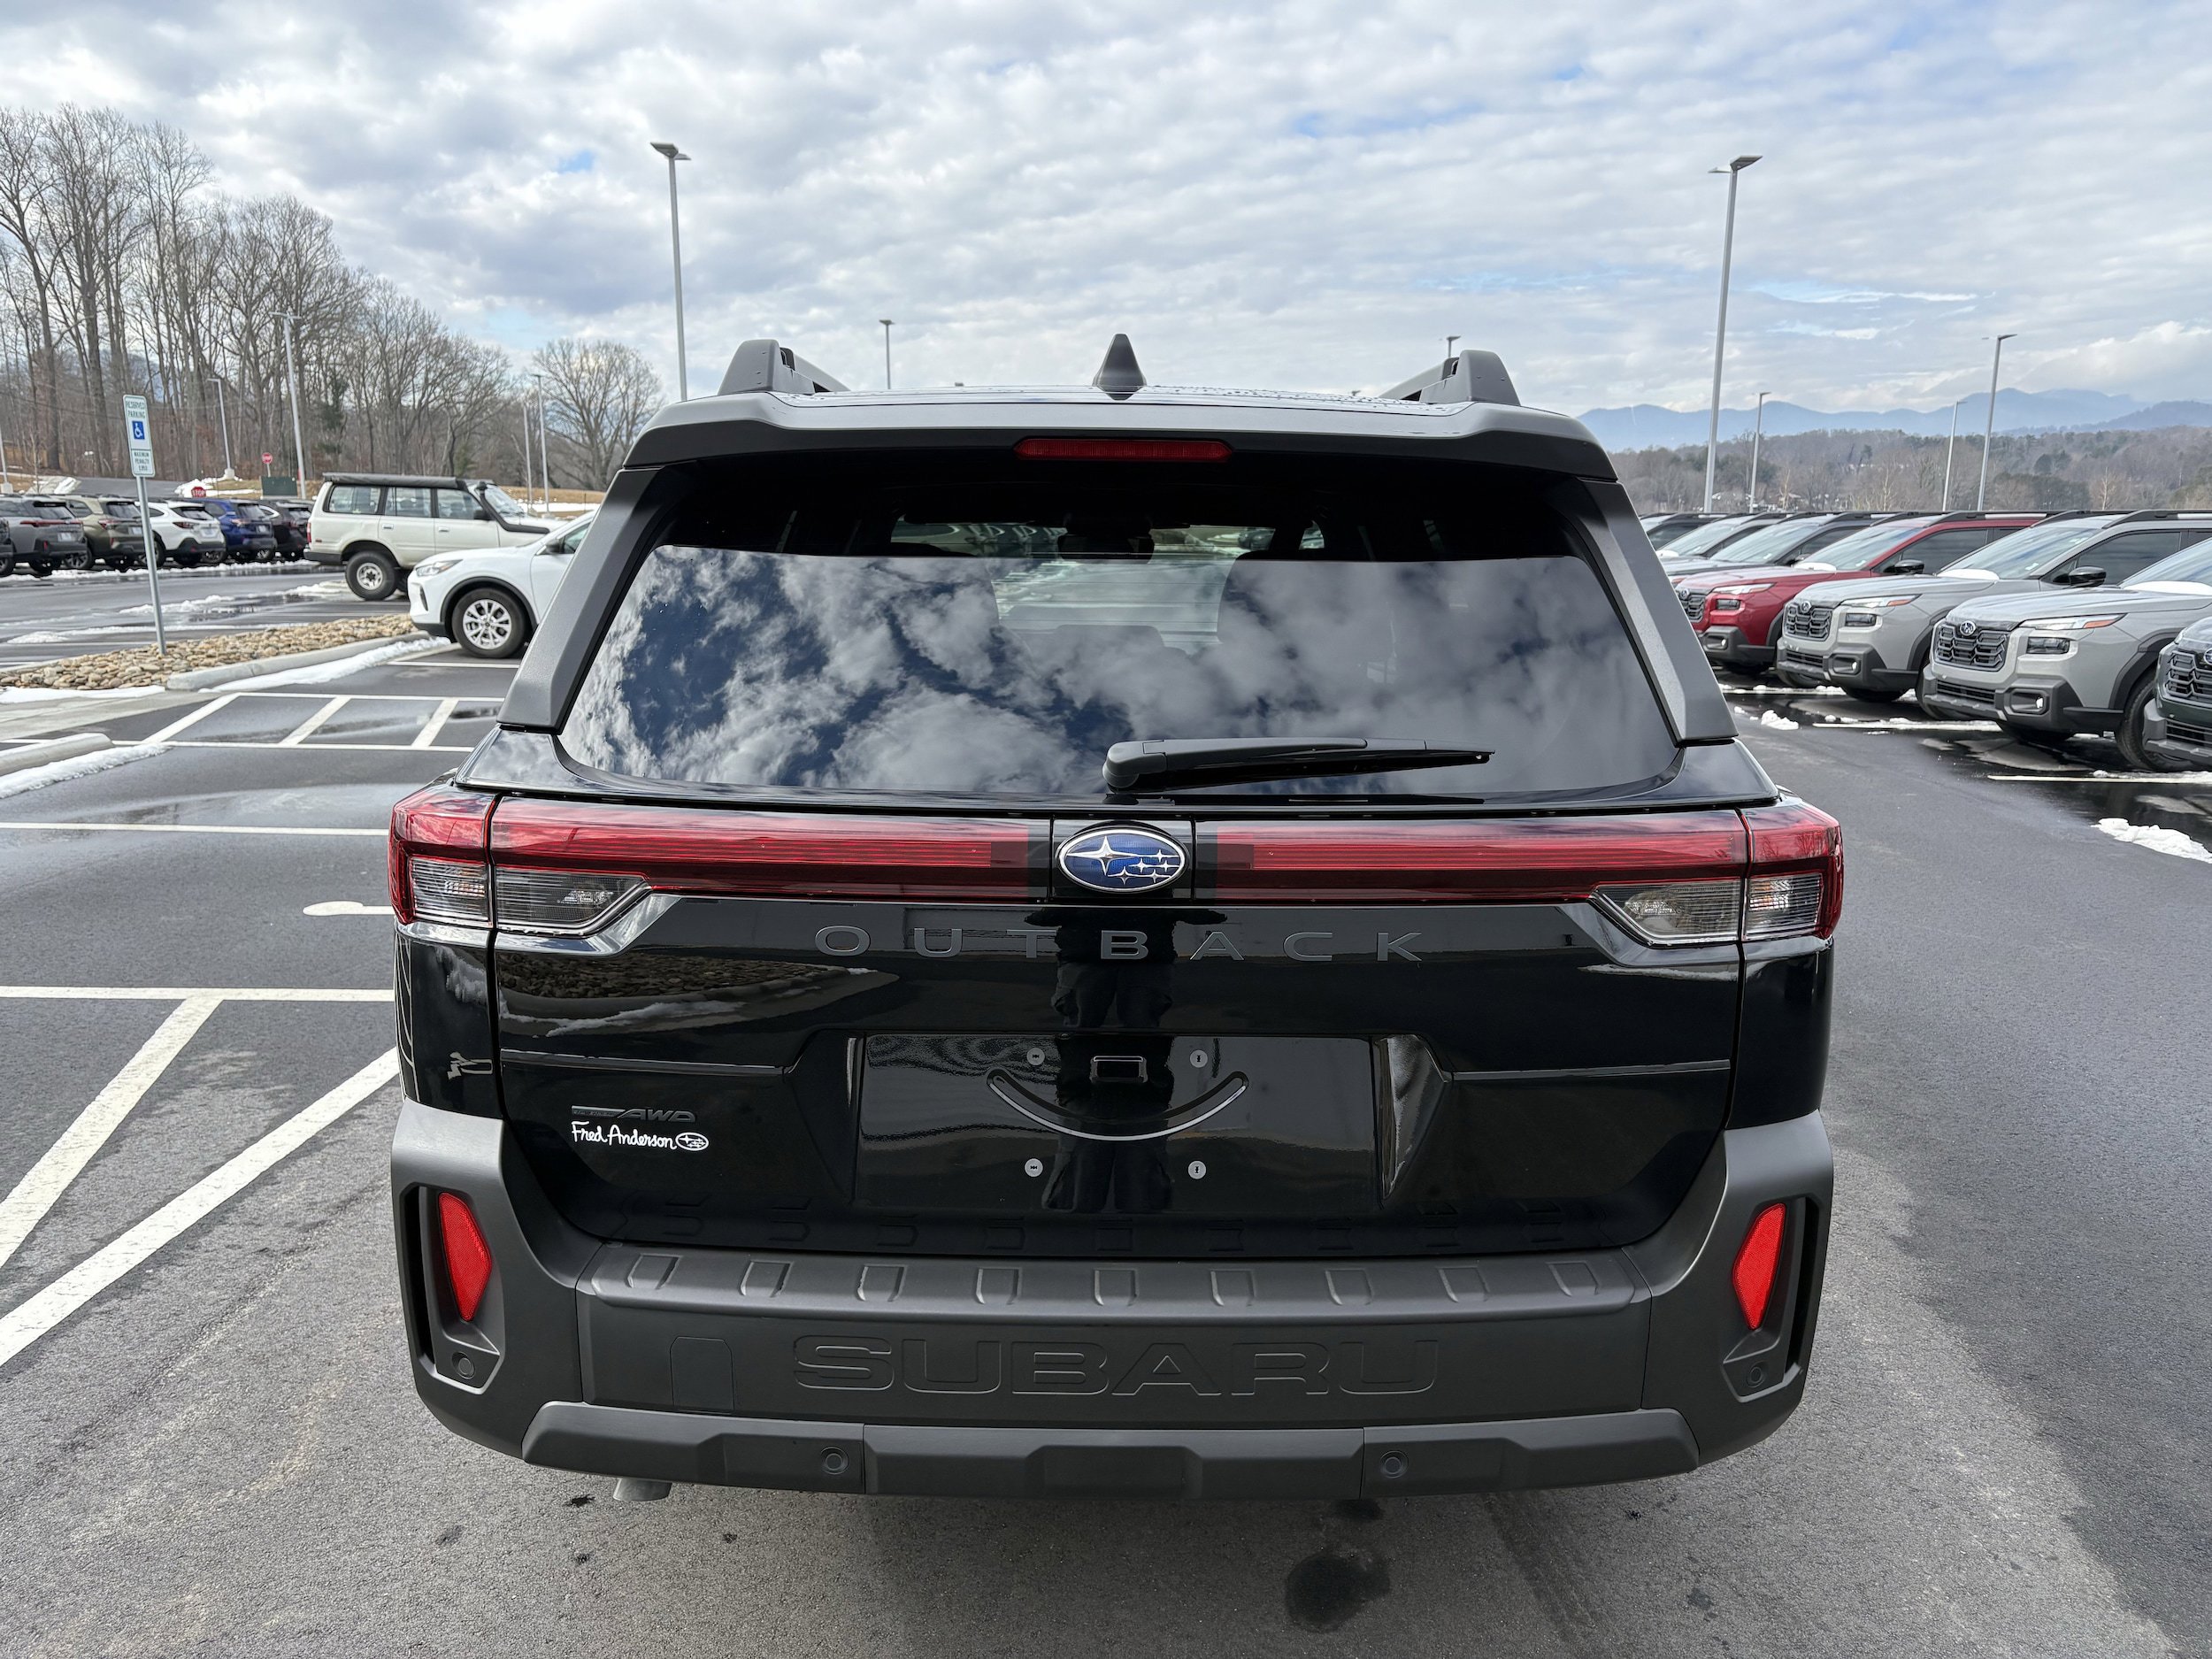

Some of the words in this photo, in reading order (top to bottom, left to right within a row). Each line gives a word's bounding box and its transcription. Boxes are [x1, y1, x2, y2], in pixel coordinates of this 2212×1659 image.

[814, 925, 1423, 962] OUTBACK
[617, 1109, 696, 1123] AWD
[572, 1121, 608, 1143] Fred
[607, 1124, 678, 1150] Anderson
[793, 1334, 1439, 1396] SUBARU
